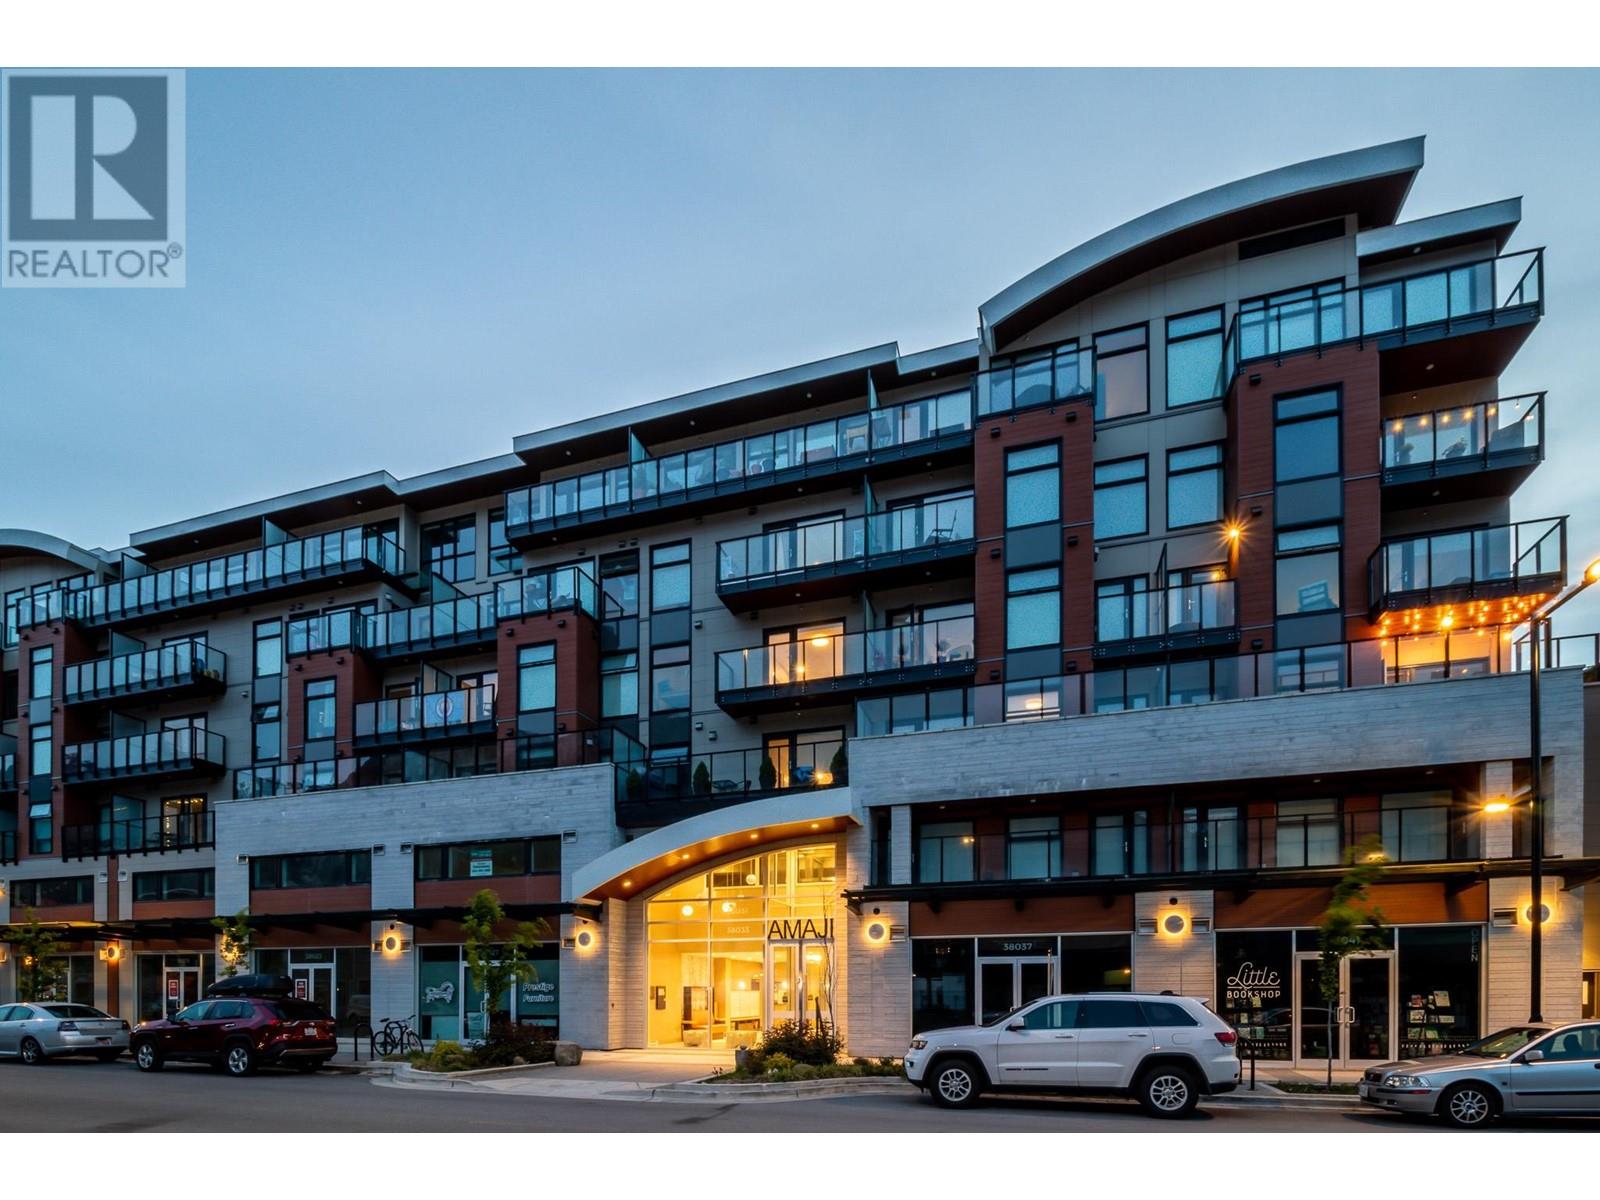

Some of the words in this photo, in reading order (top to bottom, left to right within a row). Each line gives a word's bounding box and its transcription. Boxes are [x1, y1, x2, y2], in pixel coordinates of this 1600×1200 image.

[767, 918, 834, 939] AMAJI
[1003, 942, 1033, 951] 38037
[1226, 961, 1281, 990] Little
[1226, 990, 1281, 999] BOOKSHOP
